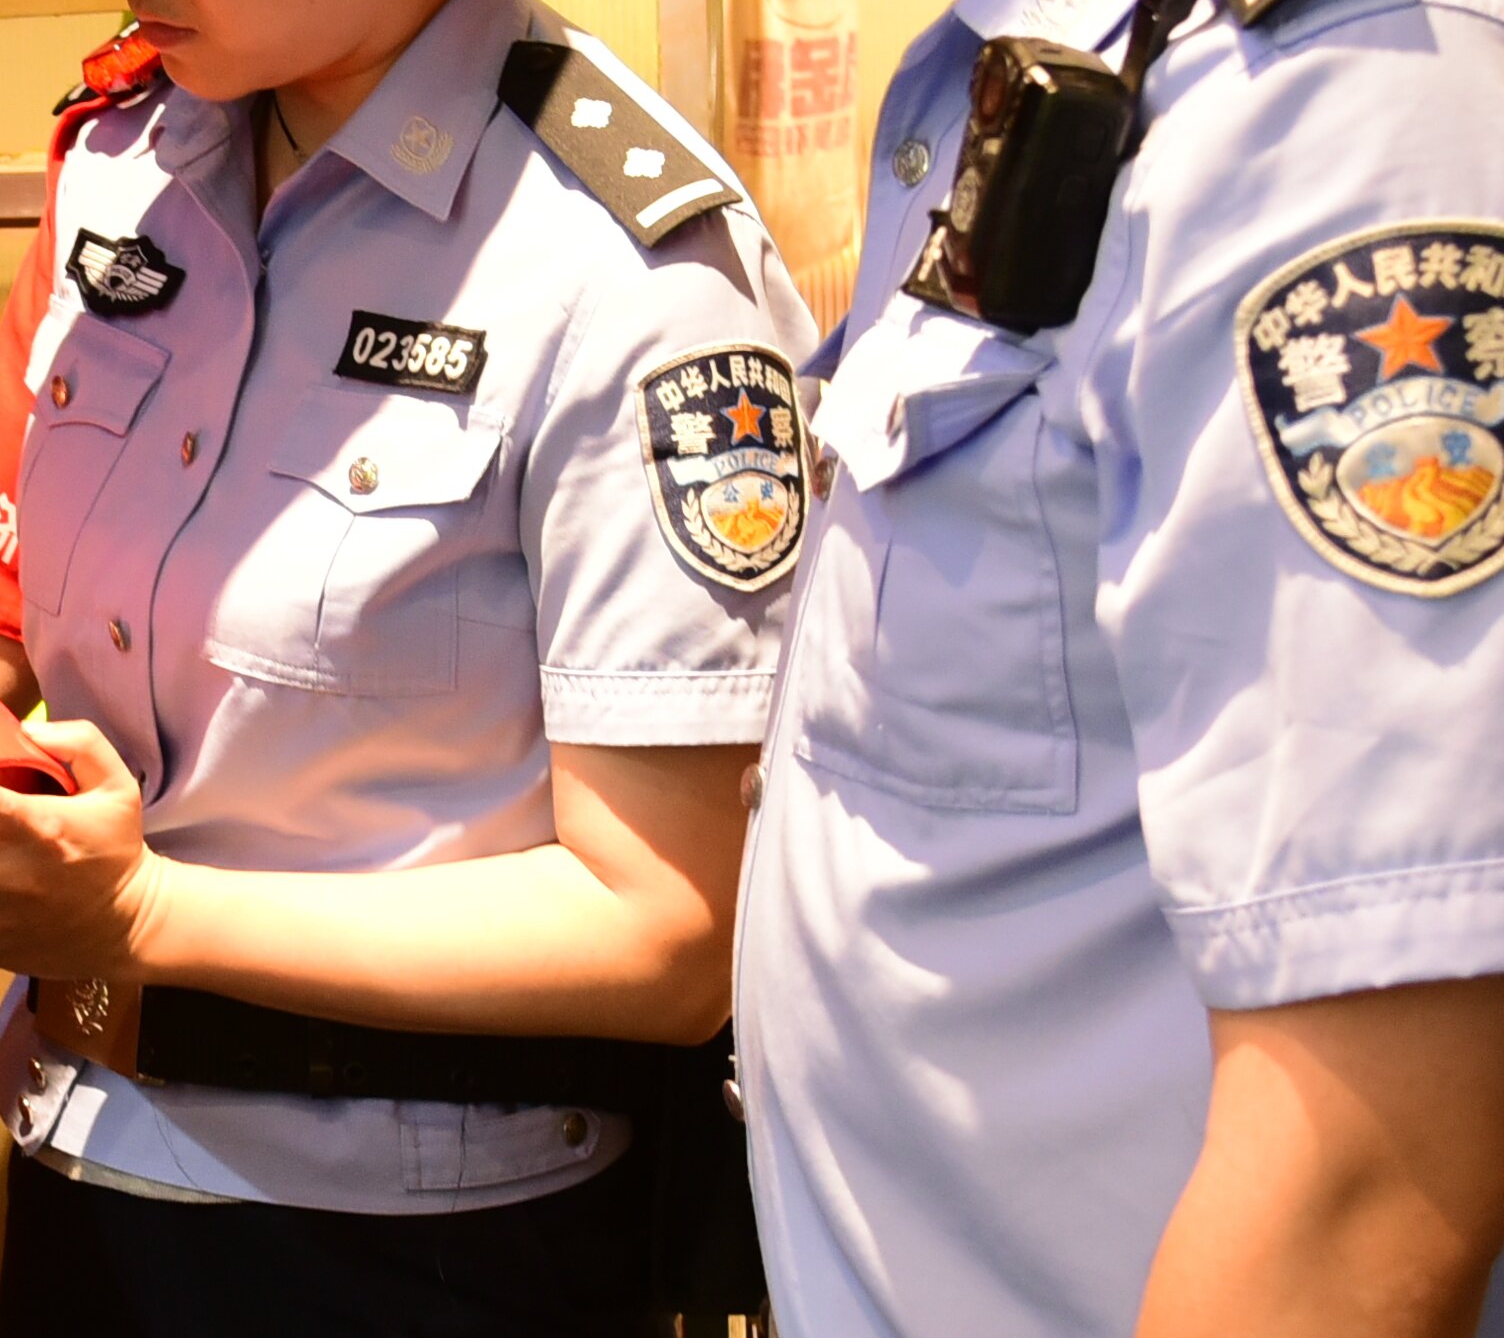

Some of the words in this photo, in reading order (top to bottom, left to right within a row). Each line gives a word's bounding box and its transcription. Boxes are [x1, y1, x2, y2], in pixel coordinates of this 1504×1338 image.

[352, 326, 474, 381] 023585
[655, 354, 792, 412] 中华人民共和国
[1347, 381, 1481, 428] POLICE
